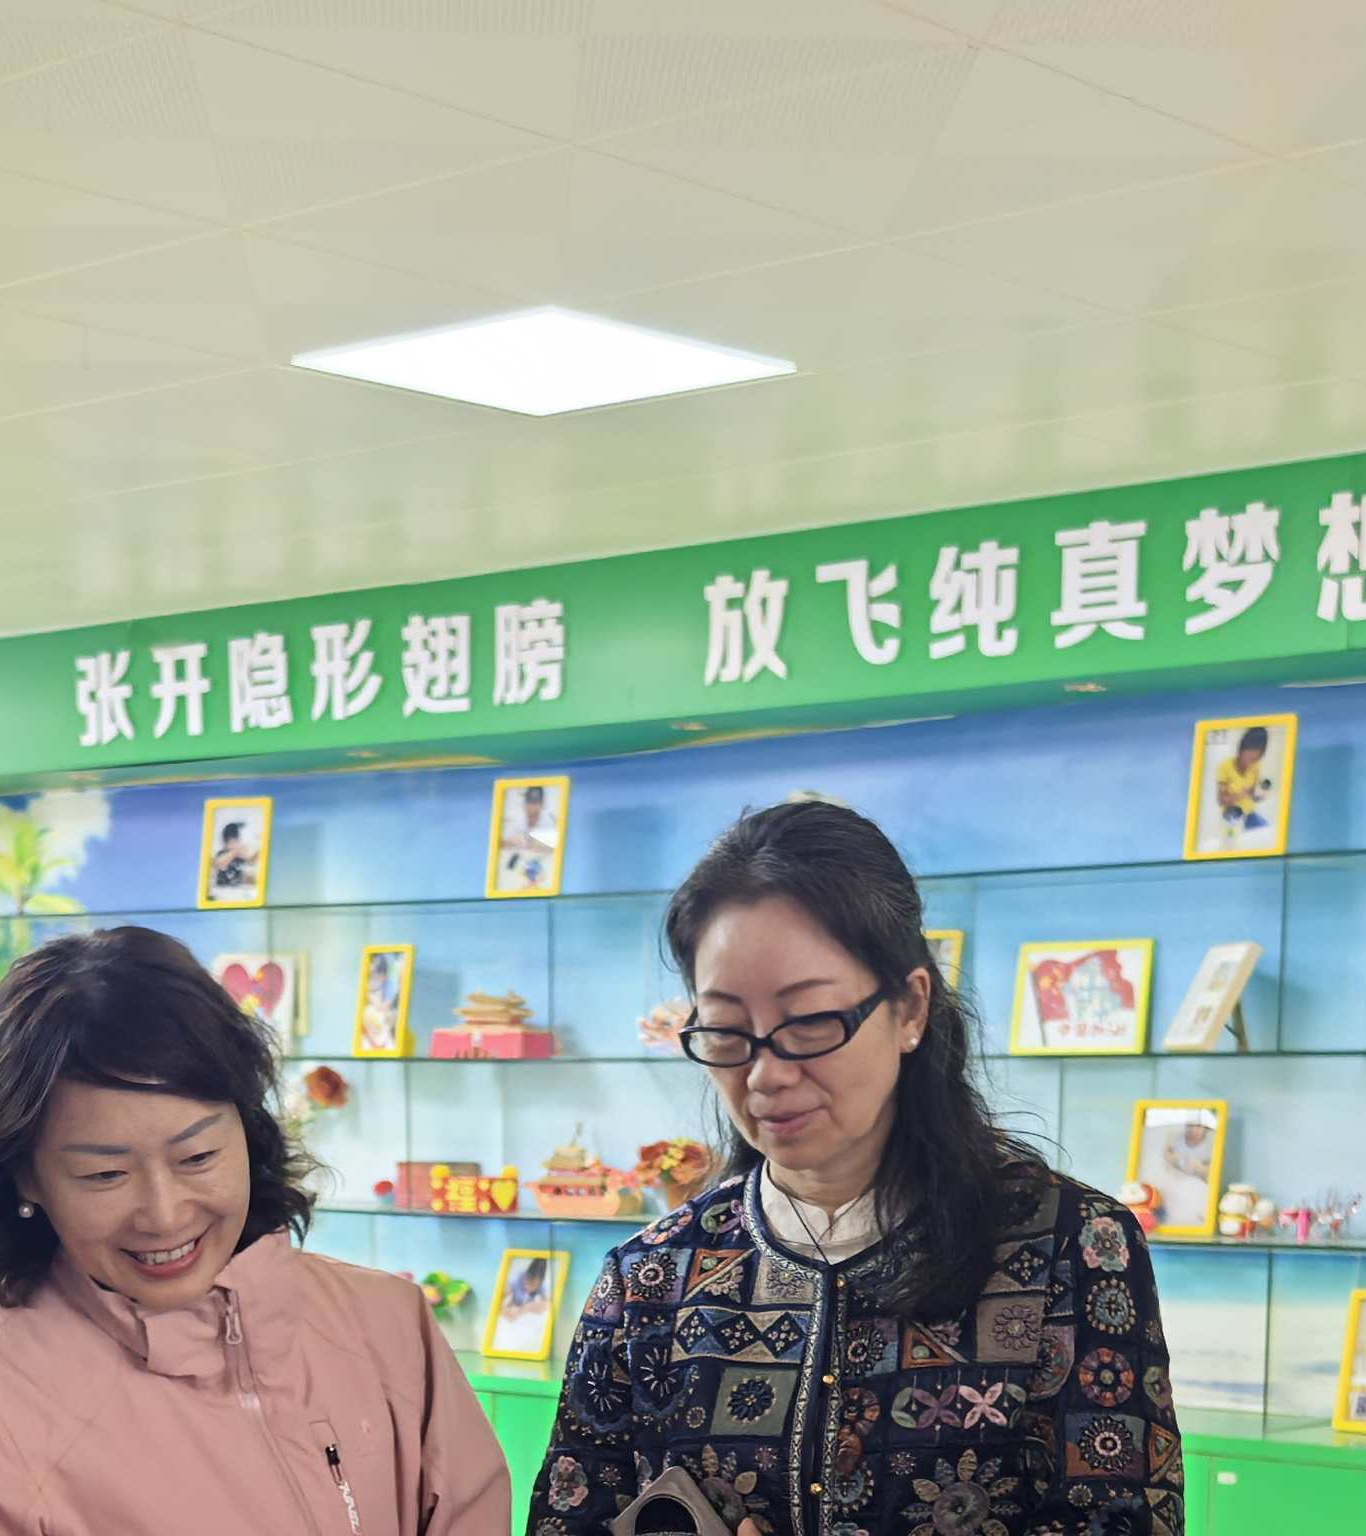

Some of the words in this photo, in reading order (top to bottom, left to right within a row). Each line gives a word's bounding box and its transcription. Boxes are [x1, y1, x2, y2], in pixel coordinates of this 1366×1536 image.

[75, 598, 567, 747] 张开隐形翅膀
